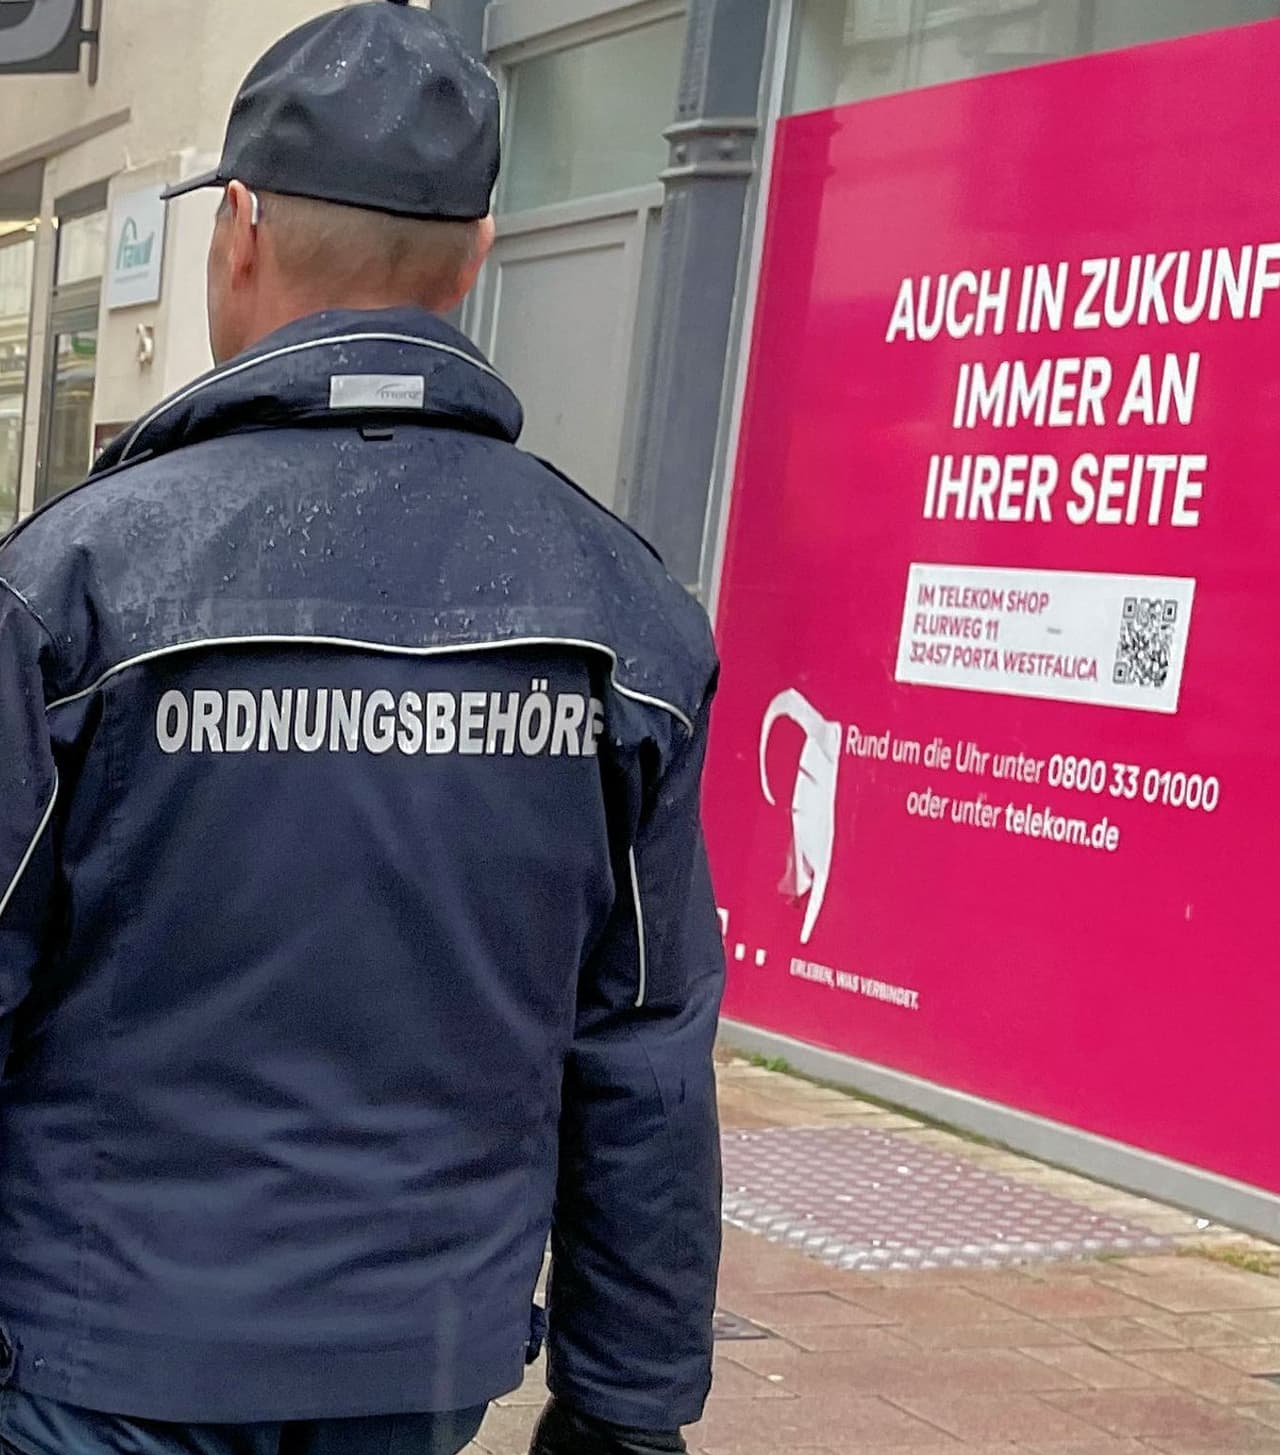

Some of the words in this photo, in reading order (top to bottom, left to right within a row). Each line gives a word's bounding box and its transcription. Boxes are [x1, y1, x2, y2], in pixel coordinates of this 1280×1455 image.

[885, 267, 1011, 343] AUCH
[1016, 262, 1068, 333] IN
[952, 356, 1113, 429] IMMER
[1117, 352, 1201, 426] AN
[923, 454, 1059, 523] IHRER
[1066, 452, 1208, 527] SEITE
[913, 613, 982, 640] FLURWEG
[985, 619, 999, 642] 11
[918, 583, 936, 606] IM
[939, 586, 1004, 612] TELEKOM
[1006, 590, 1050, 614] SHOP
[909, 641, 953, 665] 32457
[952, 646, 1000, 671] PORTA
[1003, 651, 1099, 682] WESTFALICA
[845, 725, 891, 760] Rund
[892, 738, 921, 765] um
[923, 737, 952, 771] die
[955, 741, 990, 776] Uhr
[992, 752, 1044, 784] unter
[1047, 754, 1107, 794] 0800
[1108, 763, 1140, 799] 33
[1142, 769, 1220, 812] 01000
[906, 787, 948, 820] oder
[950, 795, 1002, 829] unter
[1004, 803, 1120, 852] telekom.de
